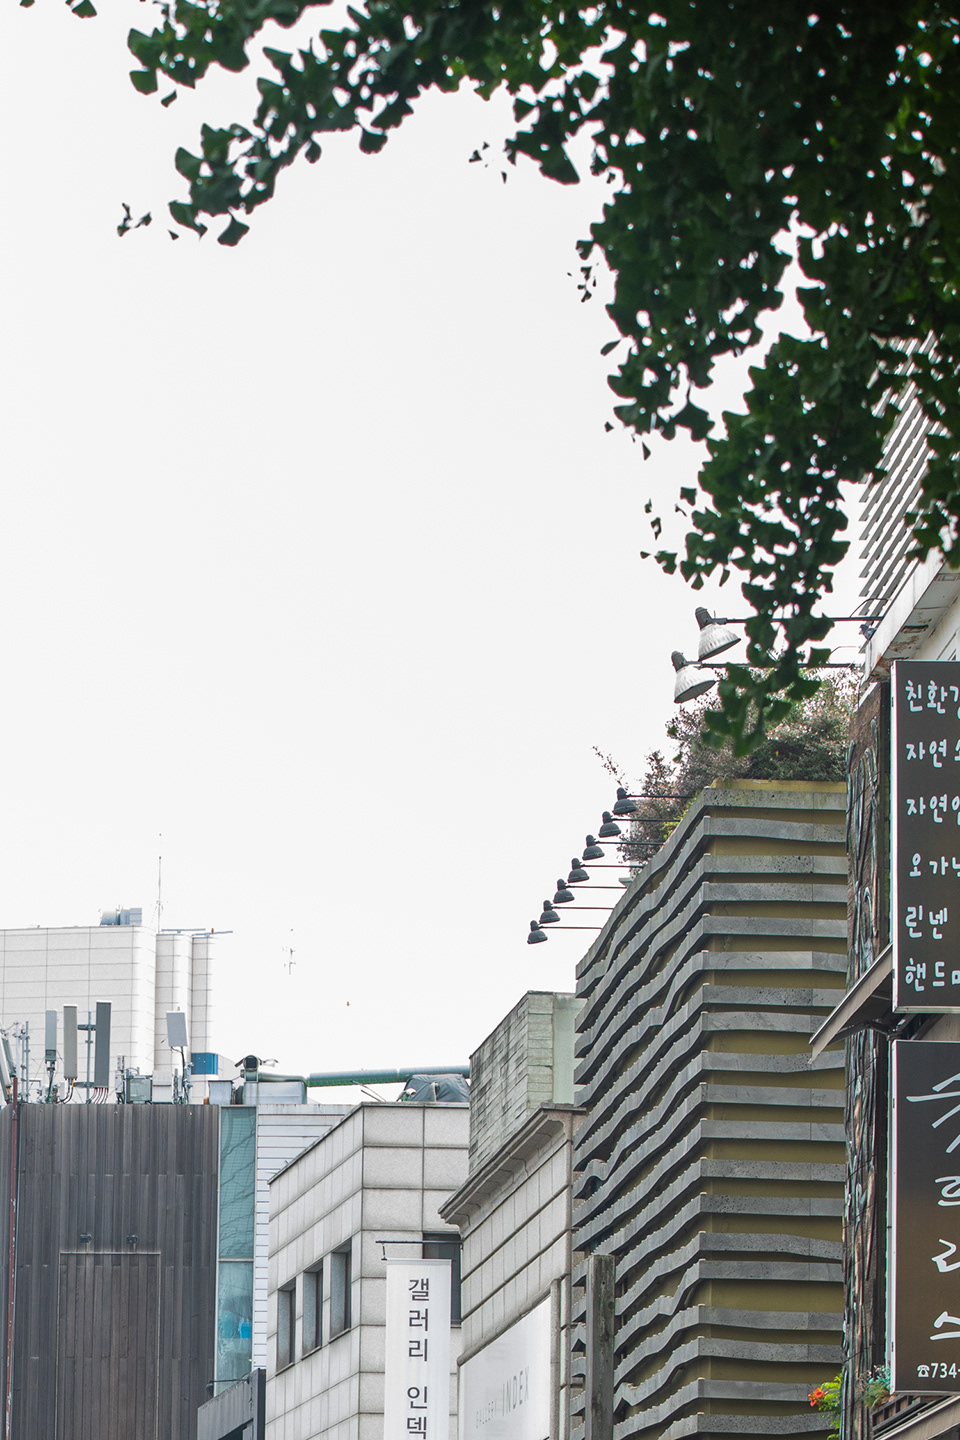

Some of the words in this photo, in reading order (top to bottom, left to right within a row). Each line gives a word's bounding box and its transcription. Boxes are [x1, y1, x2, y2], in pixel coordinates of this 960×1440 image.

[905, 905, 948, 940] 린넨
[408, 1278, 429, 1361] 갤러리
[502, 1366, 530, 1417] INDEX
